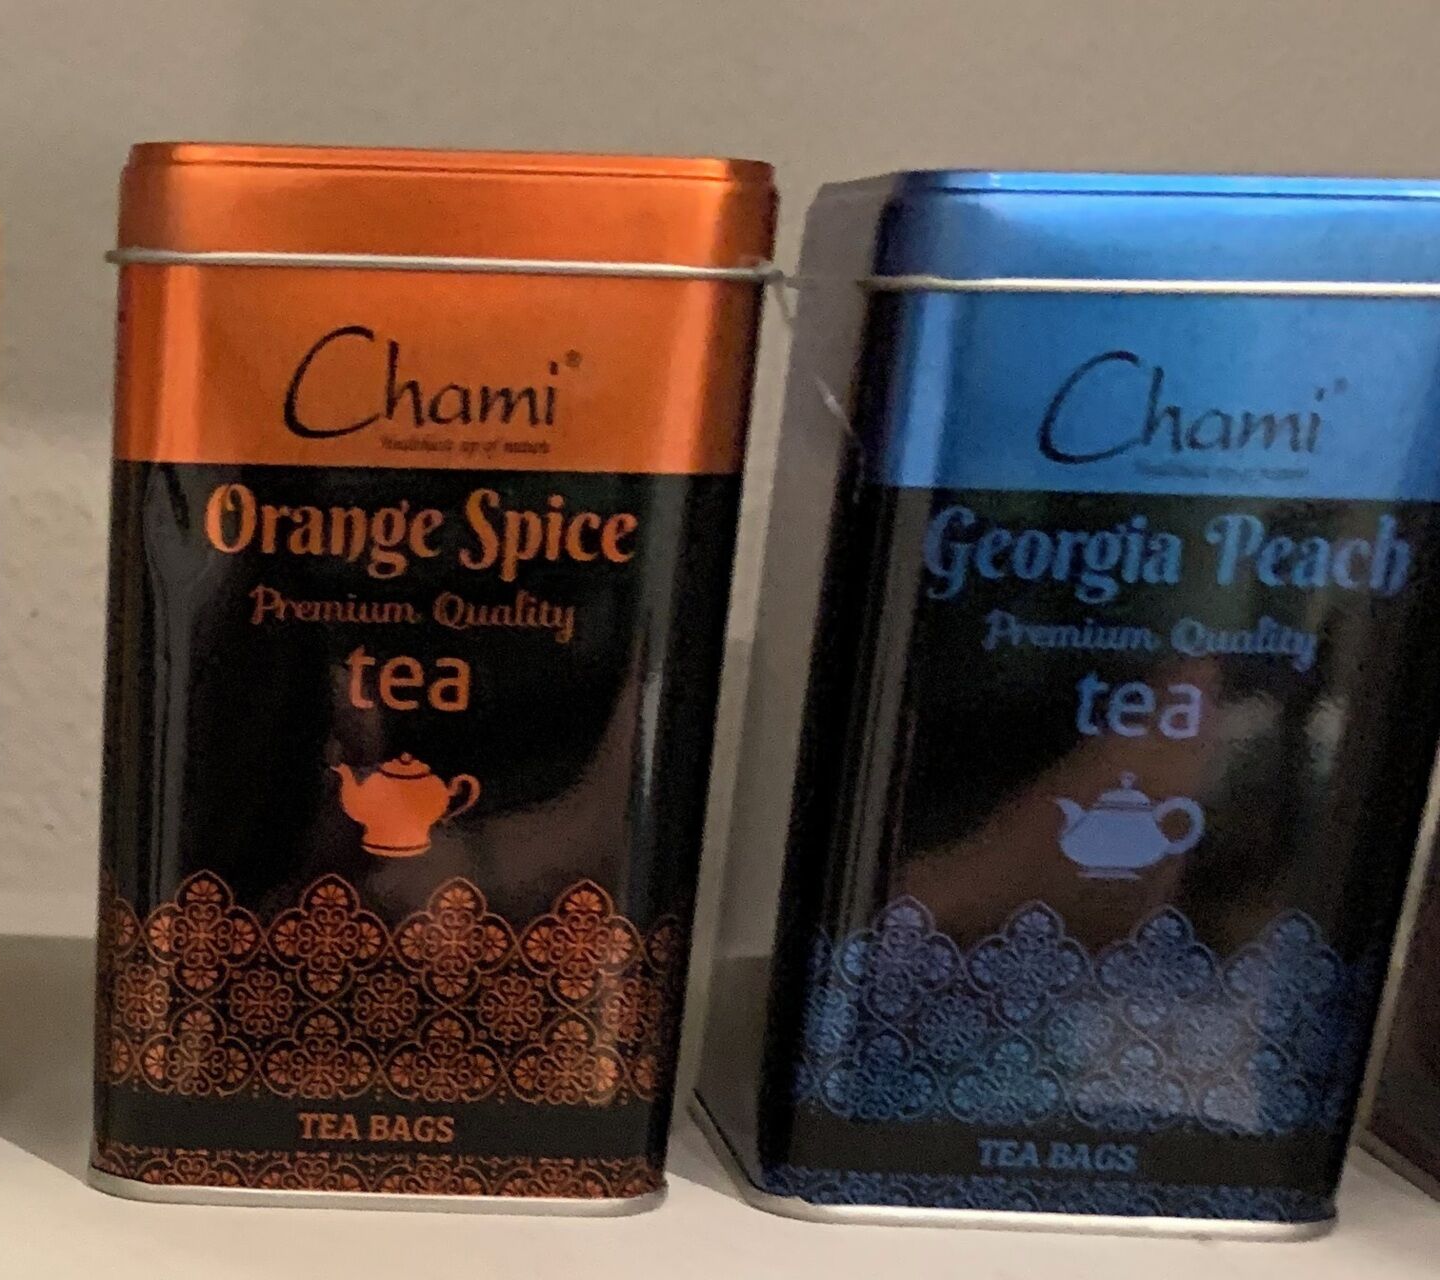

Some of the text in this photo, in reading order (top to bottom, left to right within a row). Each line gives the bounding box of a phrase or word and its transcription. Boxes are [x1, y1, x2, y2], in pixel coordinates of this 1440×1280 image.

[283, 325, 558, 439] Chami
[1036, 349, 1326, 465] Chami
[204, 482, 638, 582] Orange Spice
[923, 504, 1412, 605] Georgia Peach
[249, 584, 575, 644] Premium Quality
[981, 608, 1318, 673] Premium Quality
[345, 647, 471, 713] tea
[1075, 669, 1204, 737] tea
[298, 1112, 455, 1143] TEA BAGS
[977, 1138, 1139, 1173] TEA BAGS
